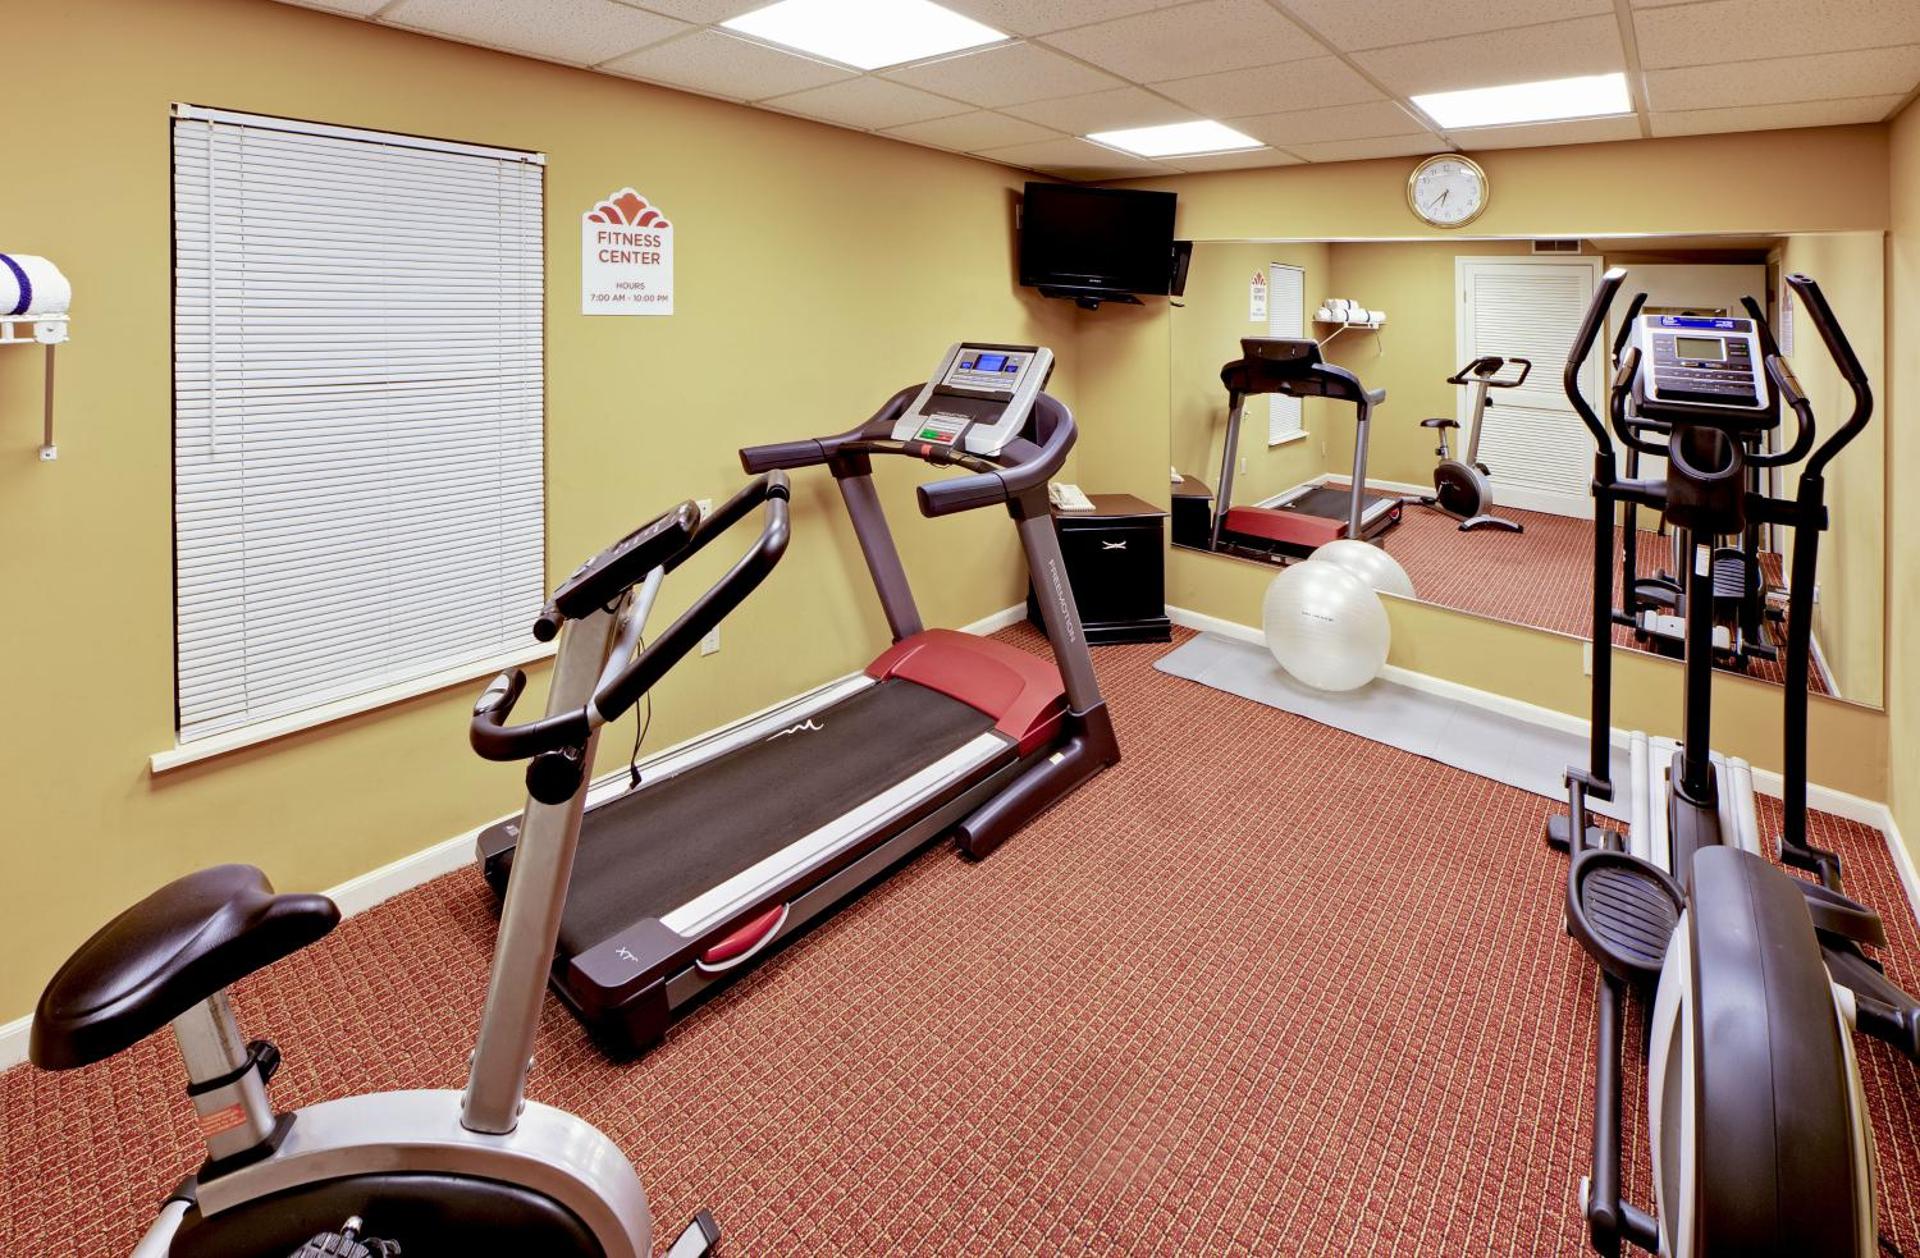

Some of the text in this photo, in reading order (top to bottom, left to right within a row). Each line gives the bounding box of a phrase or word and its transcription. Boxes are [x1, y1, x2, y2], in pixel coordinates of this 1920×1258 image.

[598, 231, 661, 248] FITNESS
[598, 249, 661, 265] CENTER
[616, 282, 646, 290] HOURS
[591, 294, 610, 302] 7:00
[612, 294, 626, 302] AM
